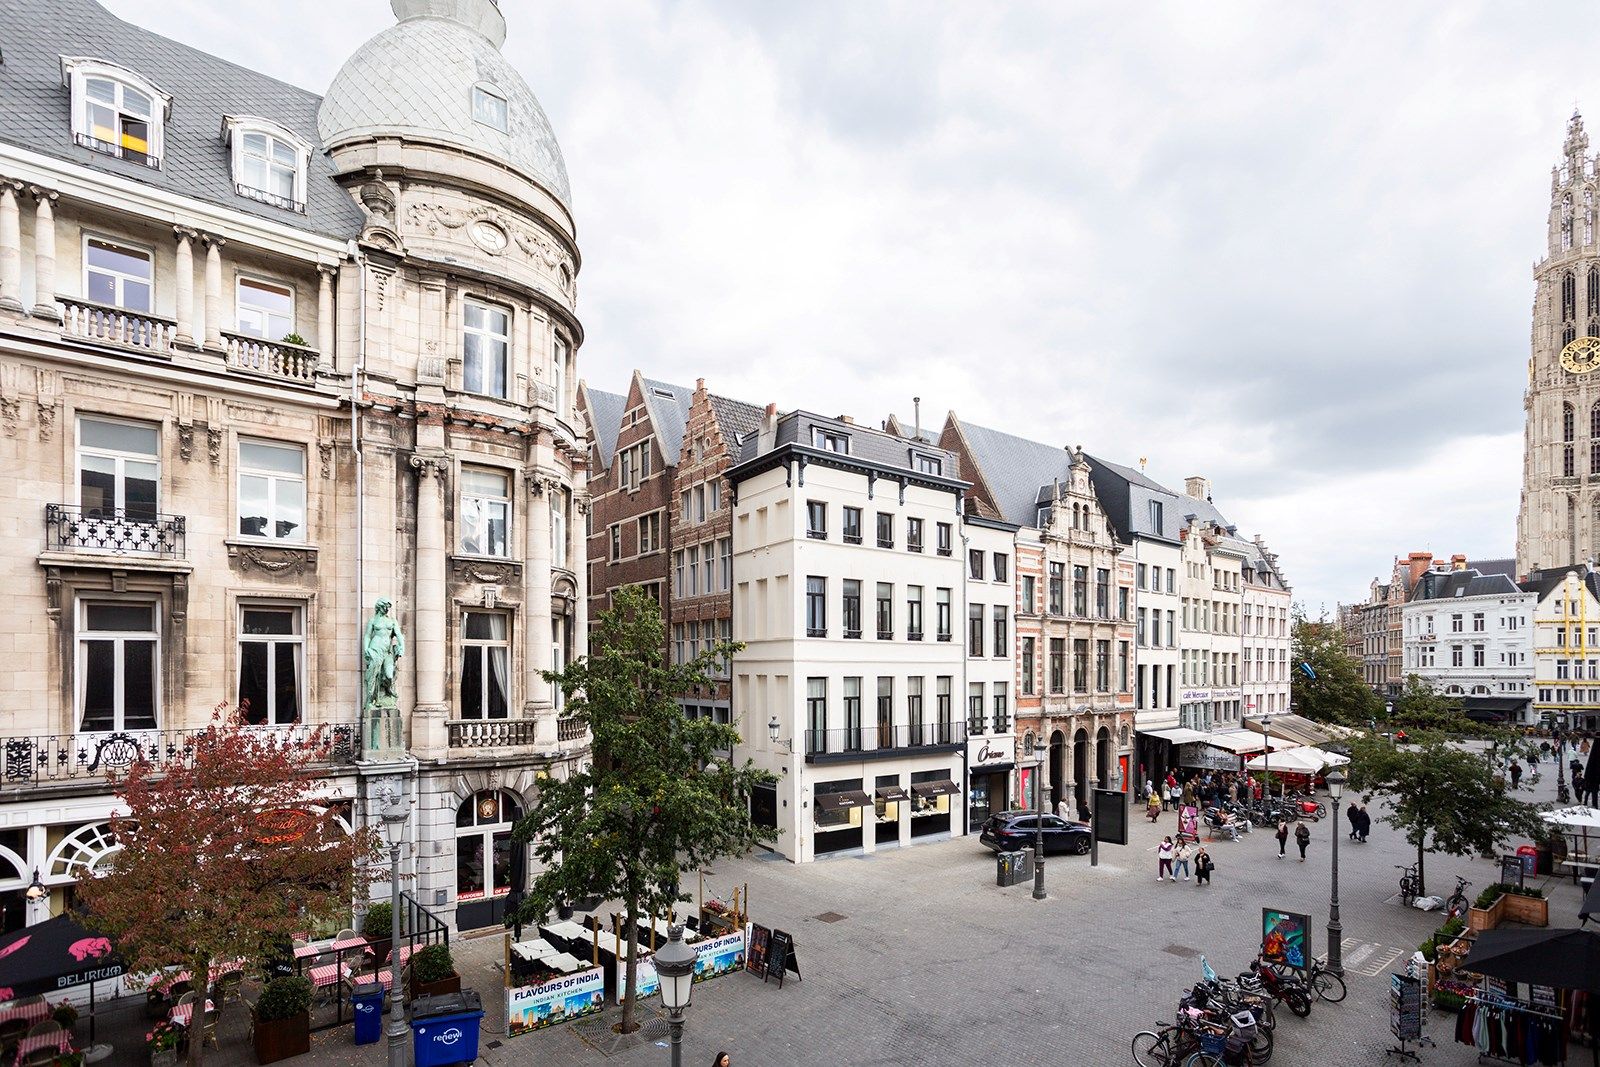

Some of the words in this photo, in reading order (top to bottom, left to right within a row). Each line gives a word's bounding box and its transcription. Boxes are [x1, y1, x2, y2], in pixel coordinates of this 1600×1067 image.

[695, 943, 713, 954] OURS
[714, 940, 722, 949] OF
[723, 935, 742, 946] INDIA
[57, 965, 123, 987] DELIRIUM
[514, 982, 563, 1001] FLAVOURS
[563, 978, 576, 988] OF
[577, 972, 600, 984] INDIA
[533, 994, 555, 1004] INDIAN
[557, 987, 583, 998] KITCHEN
[433, 1030, 462, 1042] renewi
